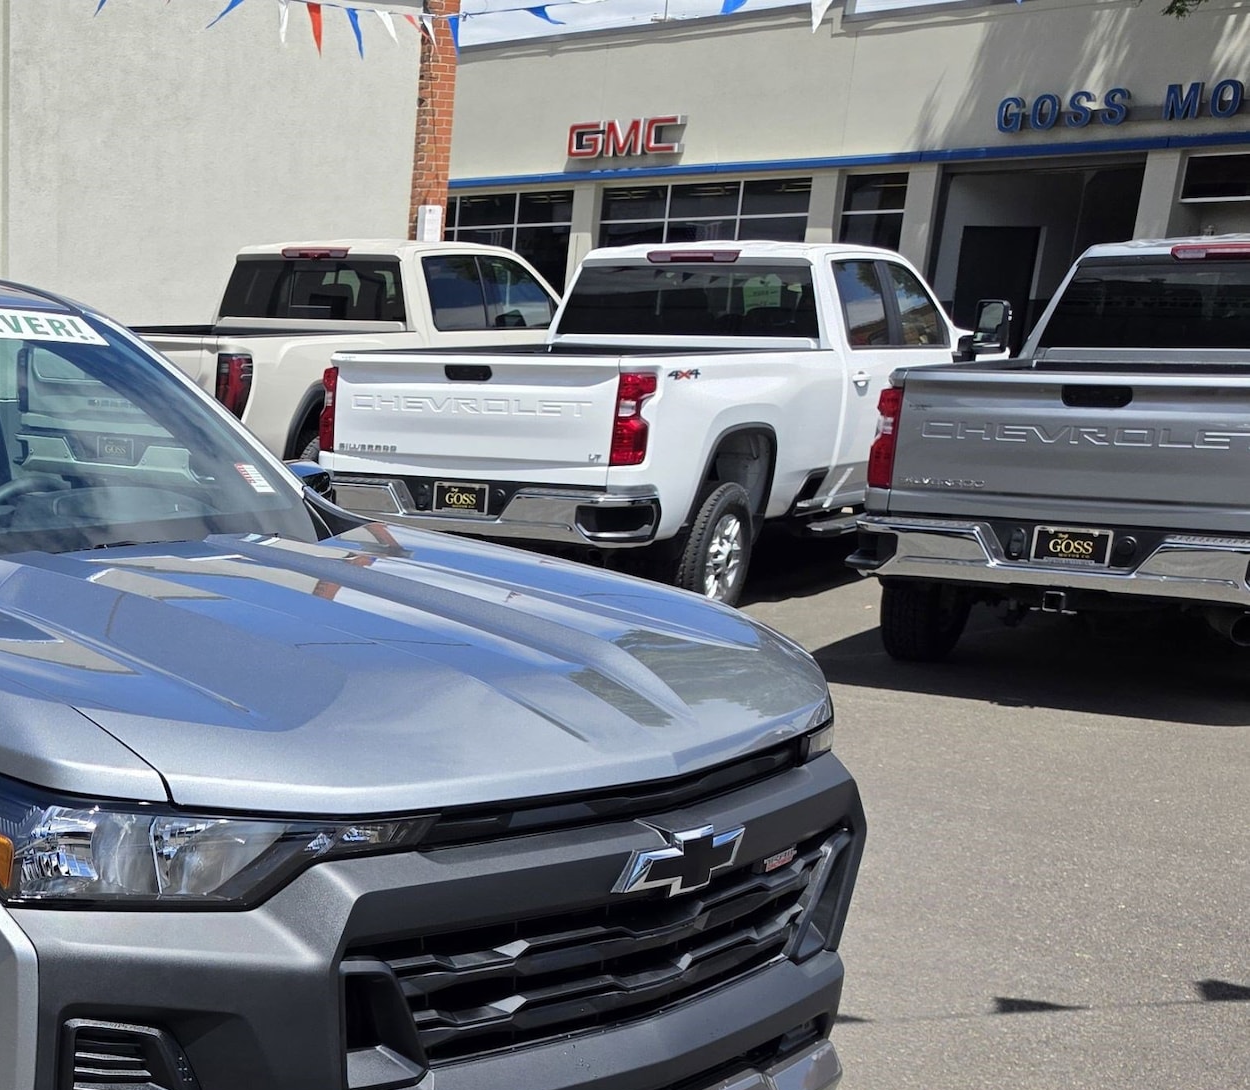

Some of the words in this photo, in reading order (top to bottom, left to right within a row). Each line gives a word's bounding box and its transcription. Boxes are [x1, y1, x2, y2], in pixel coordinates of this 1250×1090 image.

[996, 87, 1132, 134] GOSS
[567, 114, 684, 158] GMC
[351, 393, 593, 418] CHEVROLET
[445, 492, 477, 505] GOSS
[1048, 538, 1094, 555] GOSS
